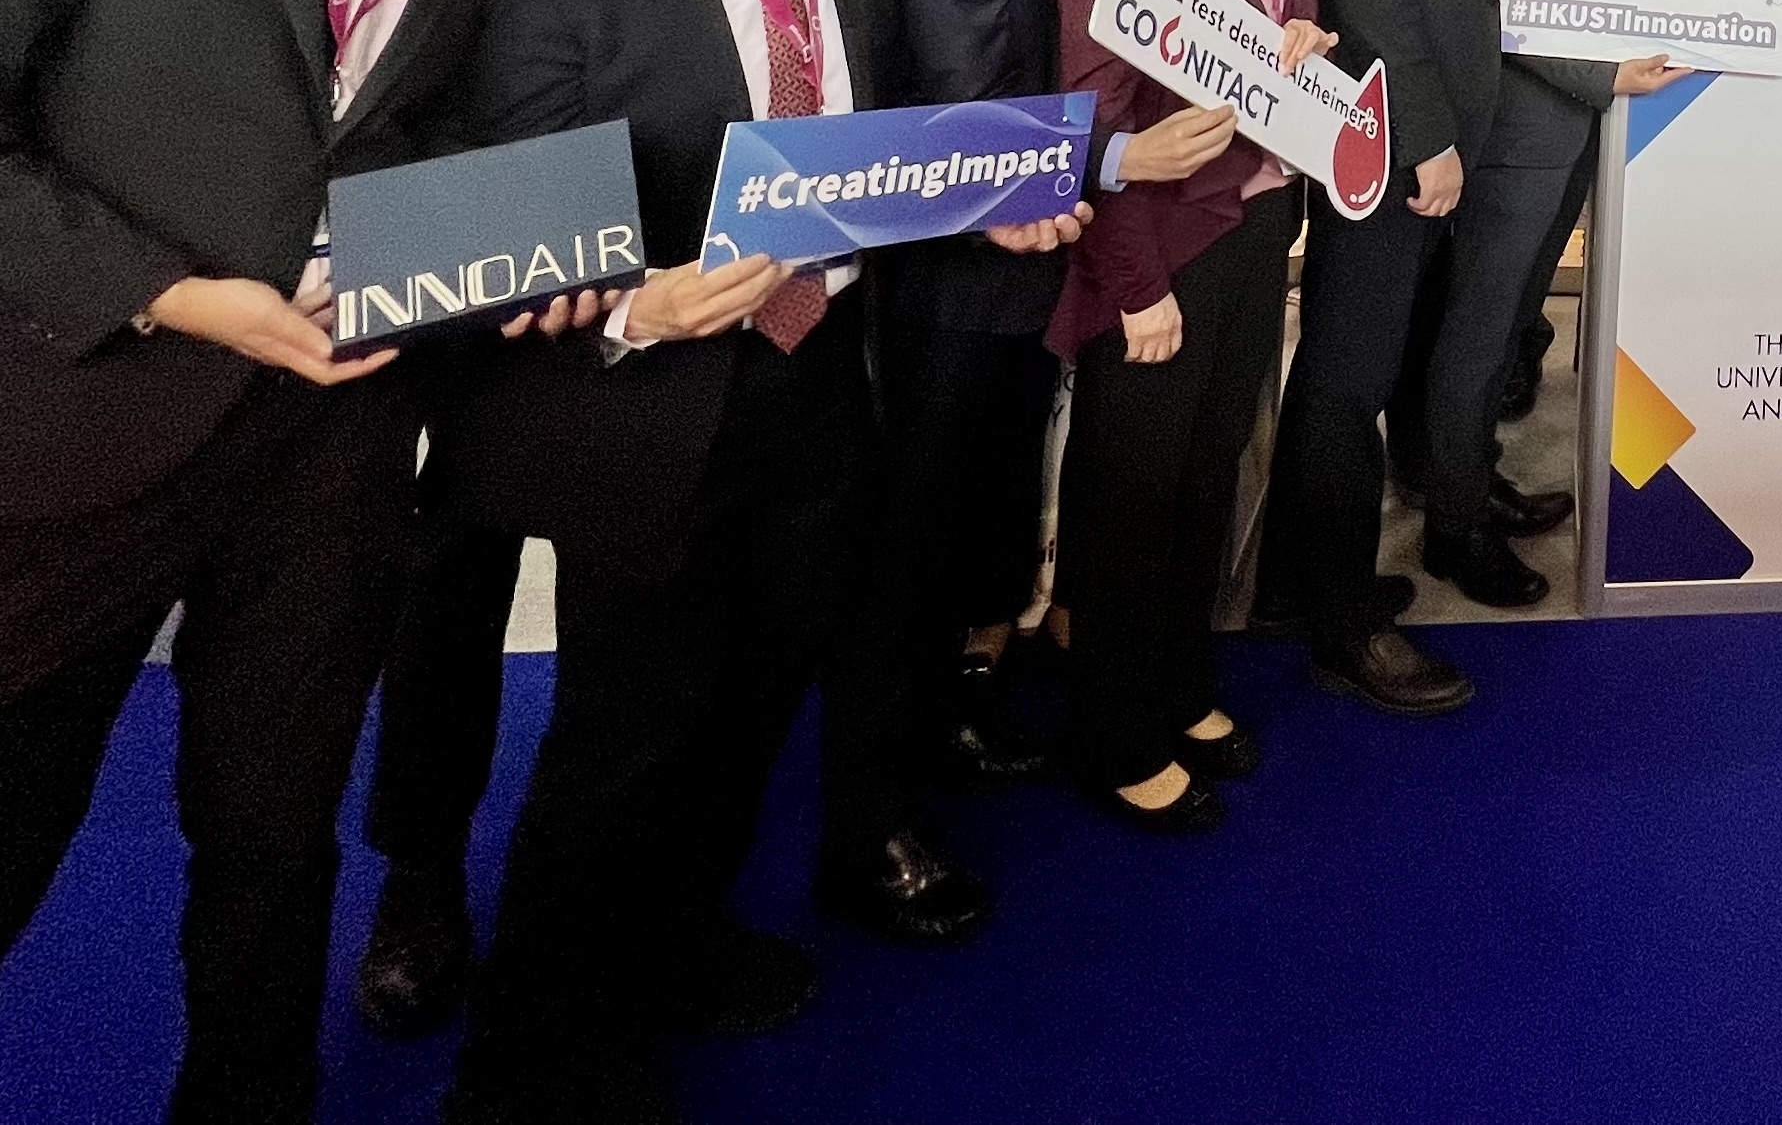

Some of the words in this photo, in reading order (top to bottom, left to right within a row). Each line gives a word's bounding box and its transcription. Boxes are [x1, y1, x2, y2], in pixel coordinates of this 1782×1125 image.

[1510, 0, 1772, 44] #HKUSTInnovation
[737, 139, 1074, 213] #CreatingImpact
[338, 224, 639, 341] INNOAIR
